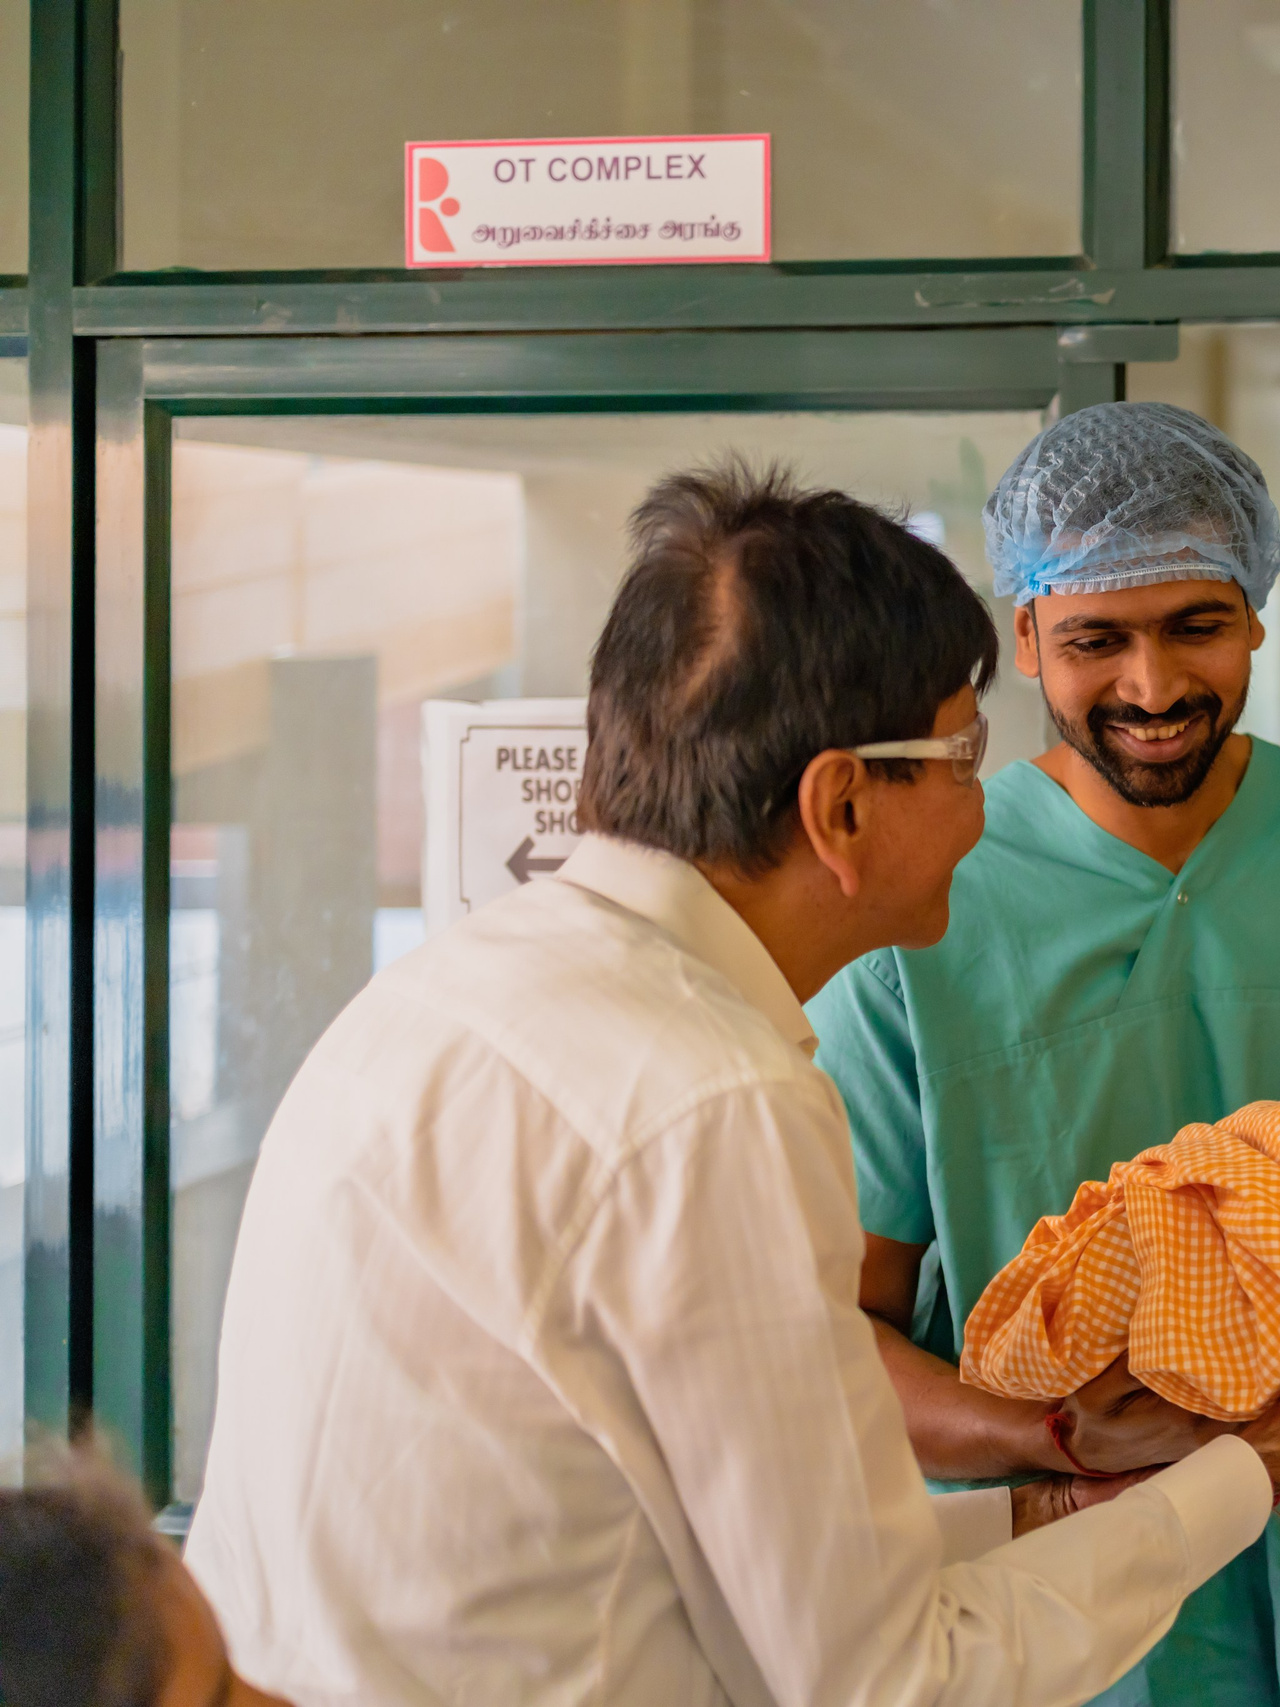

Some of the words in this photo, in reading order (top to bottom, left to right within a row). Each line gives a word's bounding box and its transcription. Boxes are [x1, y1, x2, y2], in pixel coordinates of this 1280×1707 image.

[493, 158, 537, 183] OT
[547, 154, 708, 183] COMPLEX
[471, 216, 652, 250] அறுவைசிகிச்சை
[658, 214, 742, 242] அரங்கு
[496, 747, 577, 771] PLEASE
